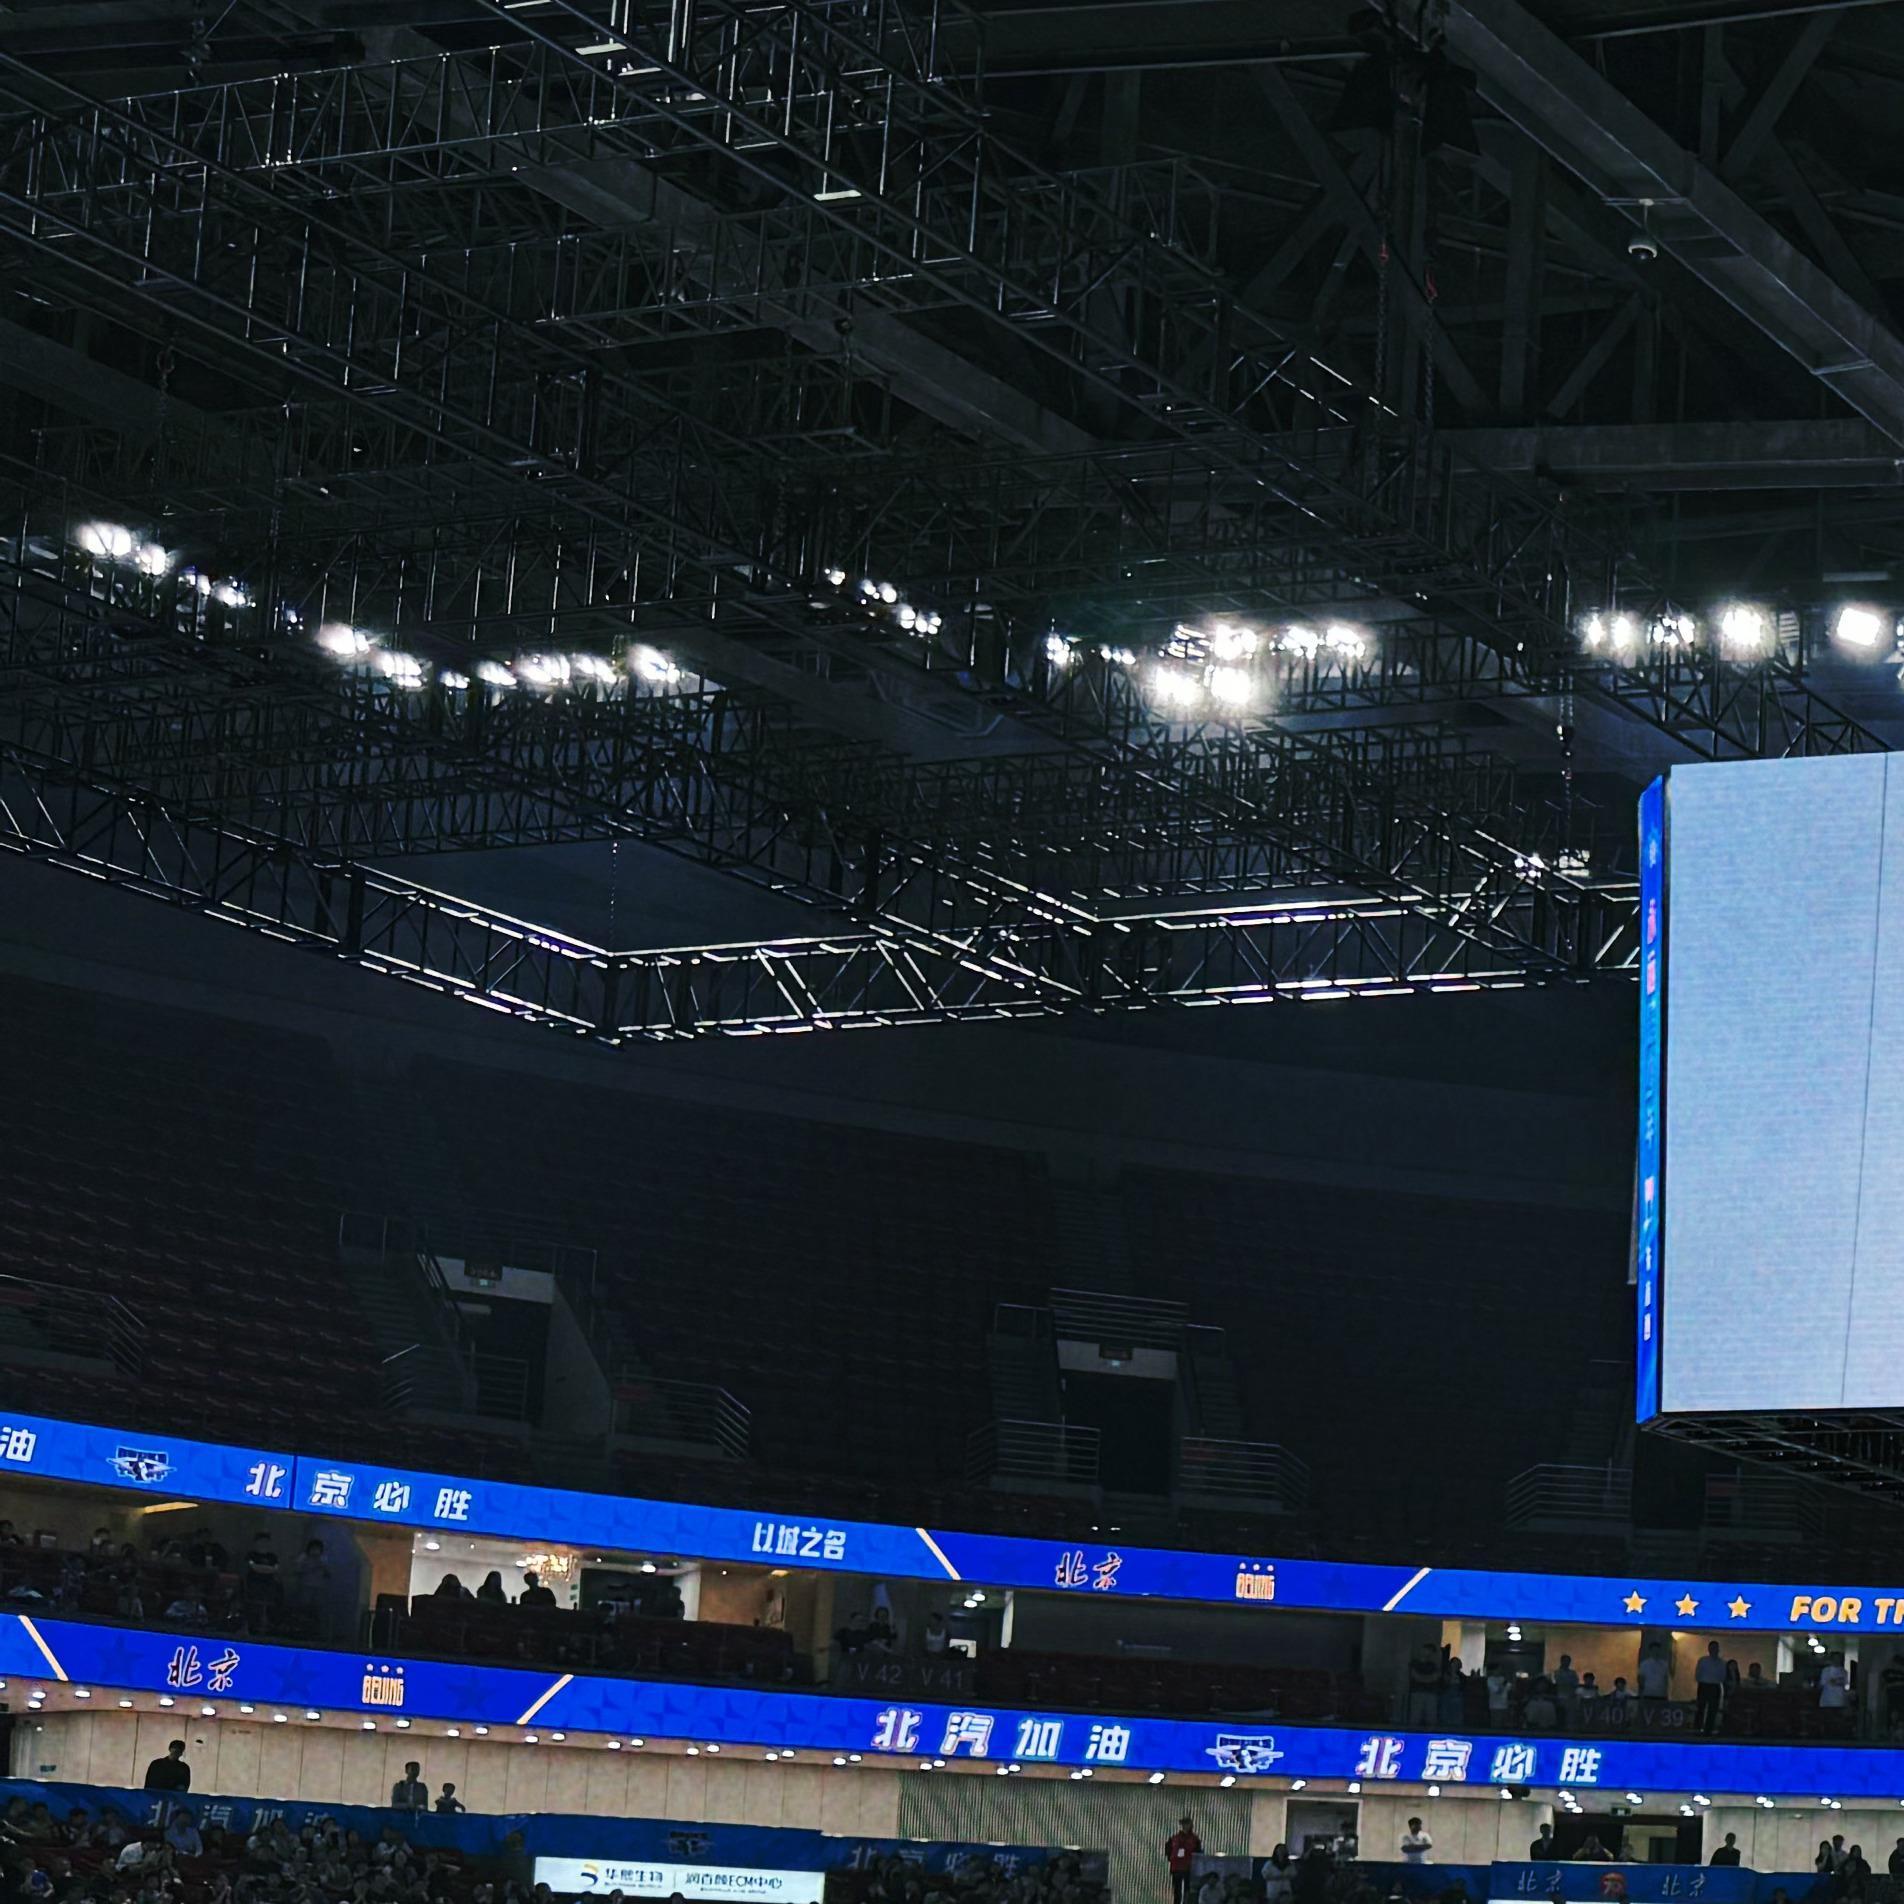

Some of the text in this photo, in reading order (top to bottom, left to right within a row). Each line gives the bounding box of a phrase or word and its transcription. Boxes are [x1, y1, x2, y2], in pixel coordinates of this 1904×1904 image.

[245, 1462, 471, 1524] 北京必胜
[752, 1521, 847, 1562] 以城之名
[1055, 1549, 1124, 1590] 北京
[1790, 1595, 1861, 1624] FOR
[167, 1646, 241, 1692] 北京
[857, 1663, 901, 1684] V 42
[921, 1667, 964, 1689] V 41
[362, 1673, 405, 1707] BEIJING
[871, 1707, 1131, 1762] 北汽加油
[1583, 1706, 1622, 1726] V 40
[1643, 1708, 1684, 1728] V 39
[1356, 1734, 1602, 1785] 北京必胜
